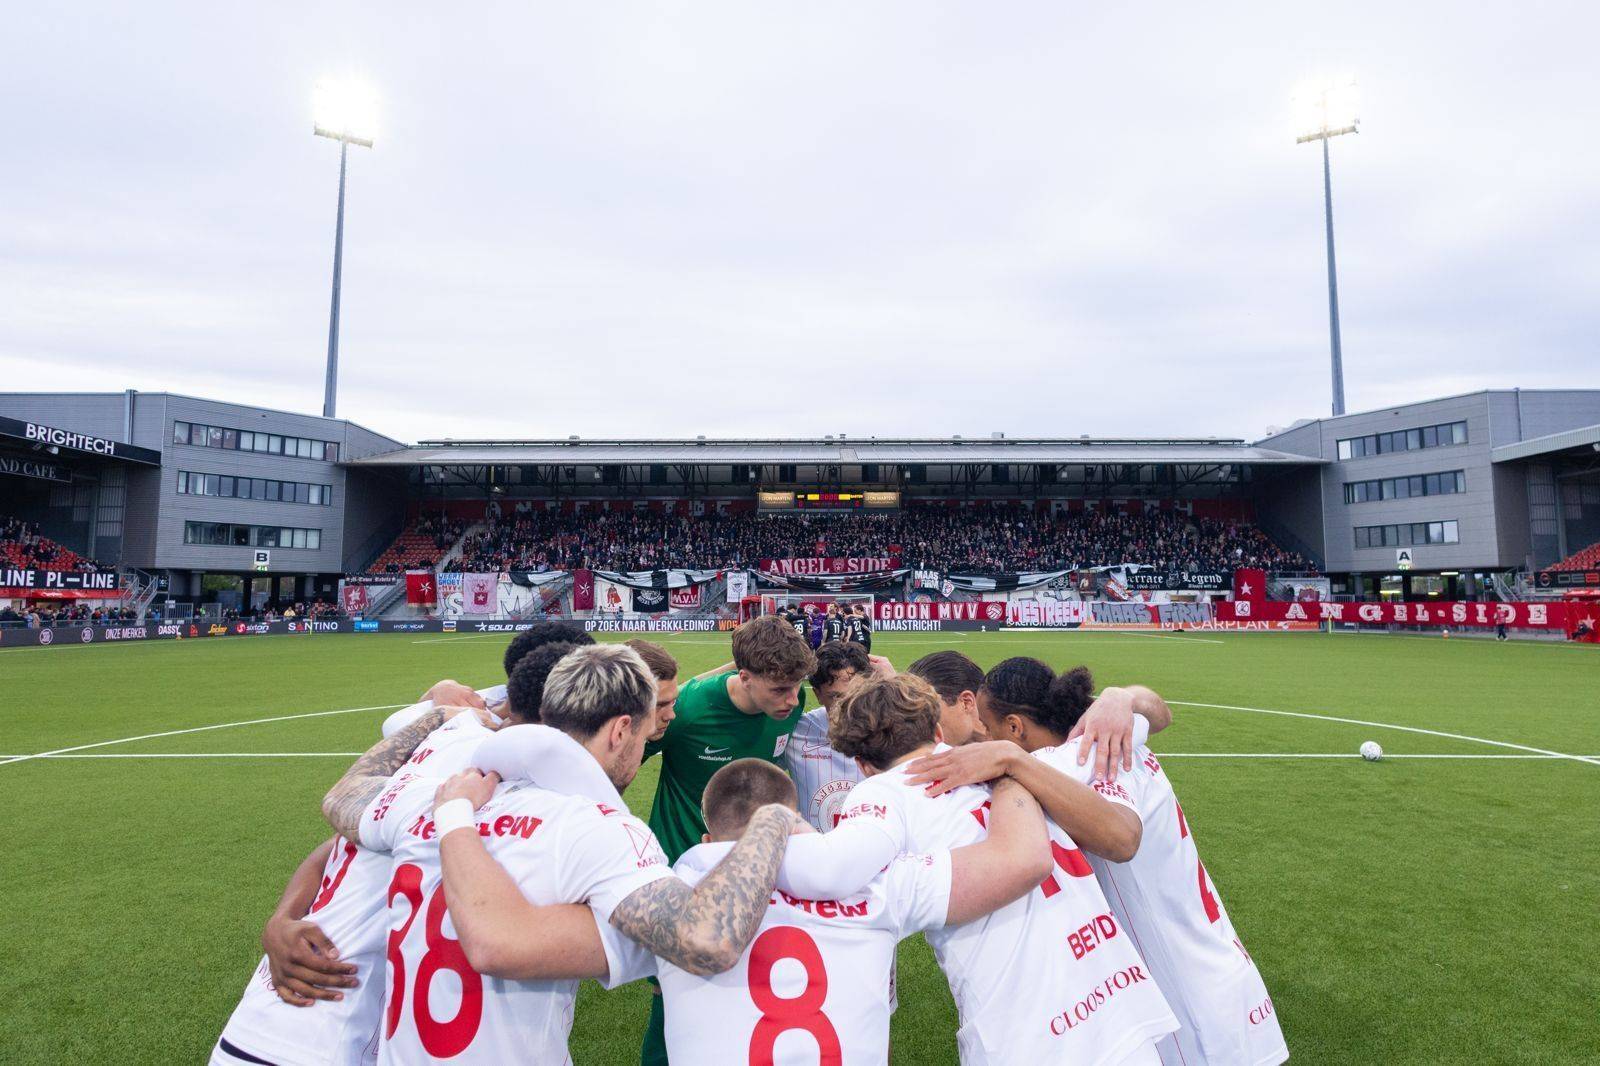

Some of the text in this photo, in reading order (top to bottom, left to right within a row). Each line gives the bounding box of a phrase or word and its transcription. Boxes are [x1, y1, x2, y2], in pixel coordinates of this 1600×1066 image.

[26, 423, 115, 455] BRIGHTECH
[0, 458, 20, 473] ND
[256, 553, 268, 563] B
[1399, 551, 1410, 561] A
[769, 557, 891, 574] ANGEL SIDE
[914, 570, 939, 581] MAAS
[1127, 571, 1223, 585] errace Legend
[938, 603, 980, 619] MVV
[1092, 603, 1153, 623] MAAS
[158, 625, 181, 635] DASSY
[288, 621, 338, 631] SANTINO
[585, 620, 597, 632] OP
[598, 620, 621, 632] ZOEK
[623, 620, 646, 632] NAAR
[648, 620, 715, 632] WERKKLEDING?
[833, 623, 840, 634] 11
[853, 620, 862, 632] 27
[882, 620, 941, 632] MAASTRICHT!
[105, 628, 121, 640] ONZE
[747, 925, 843, 1066] 8
[1050, 985, 1105, 1037] CLOOS
